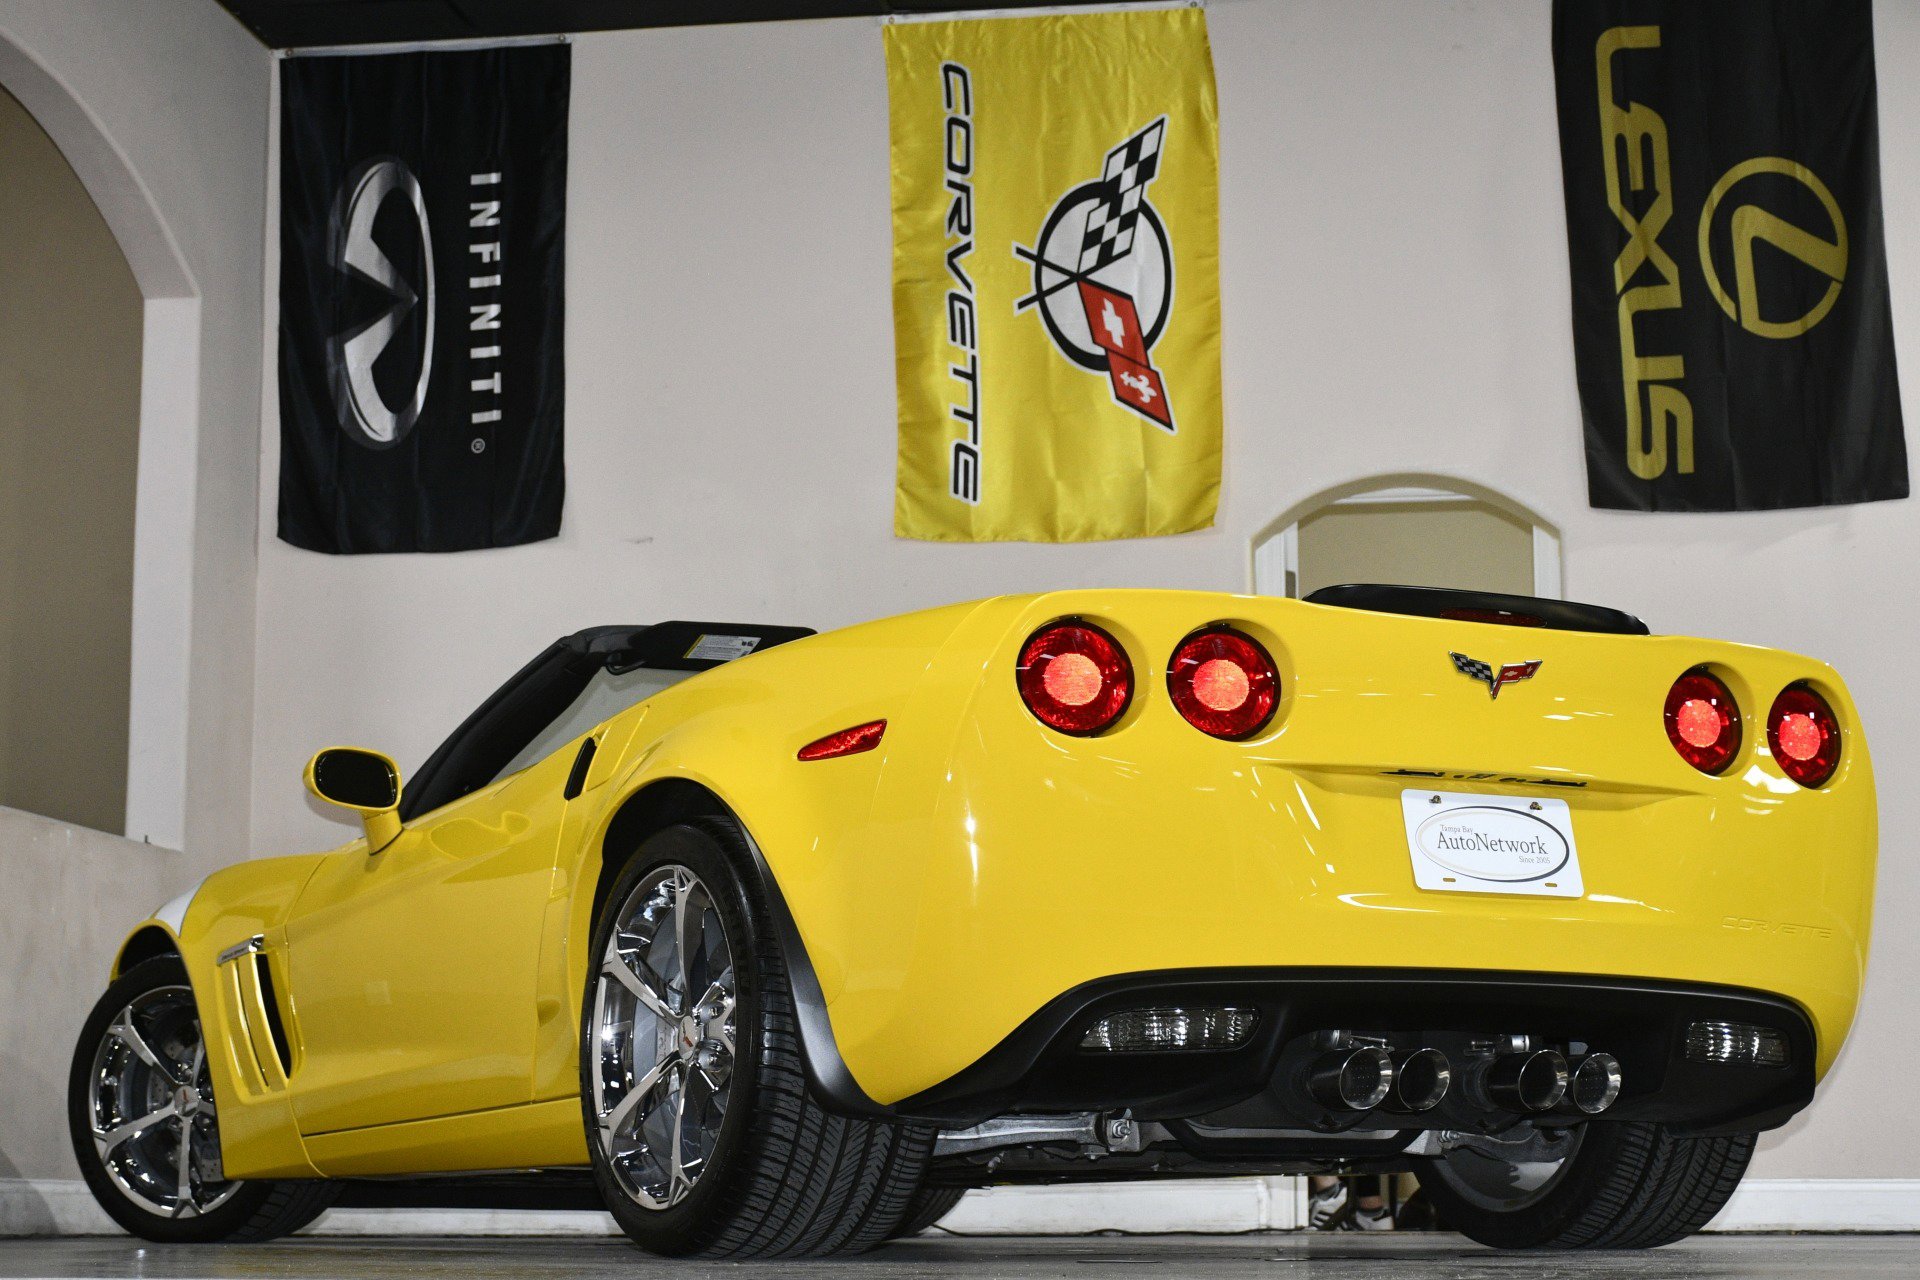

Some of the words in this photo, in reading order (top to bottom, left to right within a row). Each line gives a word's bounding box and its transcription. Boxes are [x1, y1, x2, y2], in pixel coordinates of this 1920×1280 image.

[470, 171, 503, 425] INFINITI
[942, 61, 979, 505] CORVETTE
[1595, 25, 1694, 480] LEXUS
[1437, 831, 1548, 855] AutoNetwork
[1440, 825, 1461, 833] Tampa
[1462, 826, 1473, 835] Bay
[1722, 916, 1832, 939] CORVETTE
